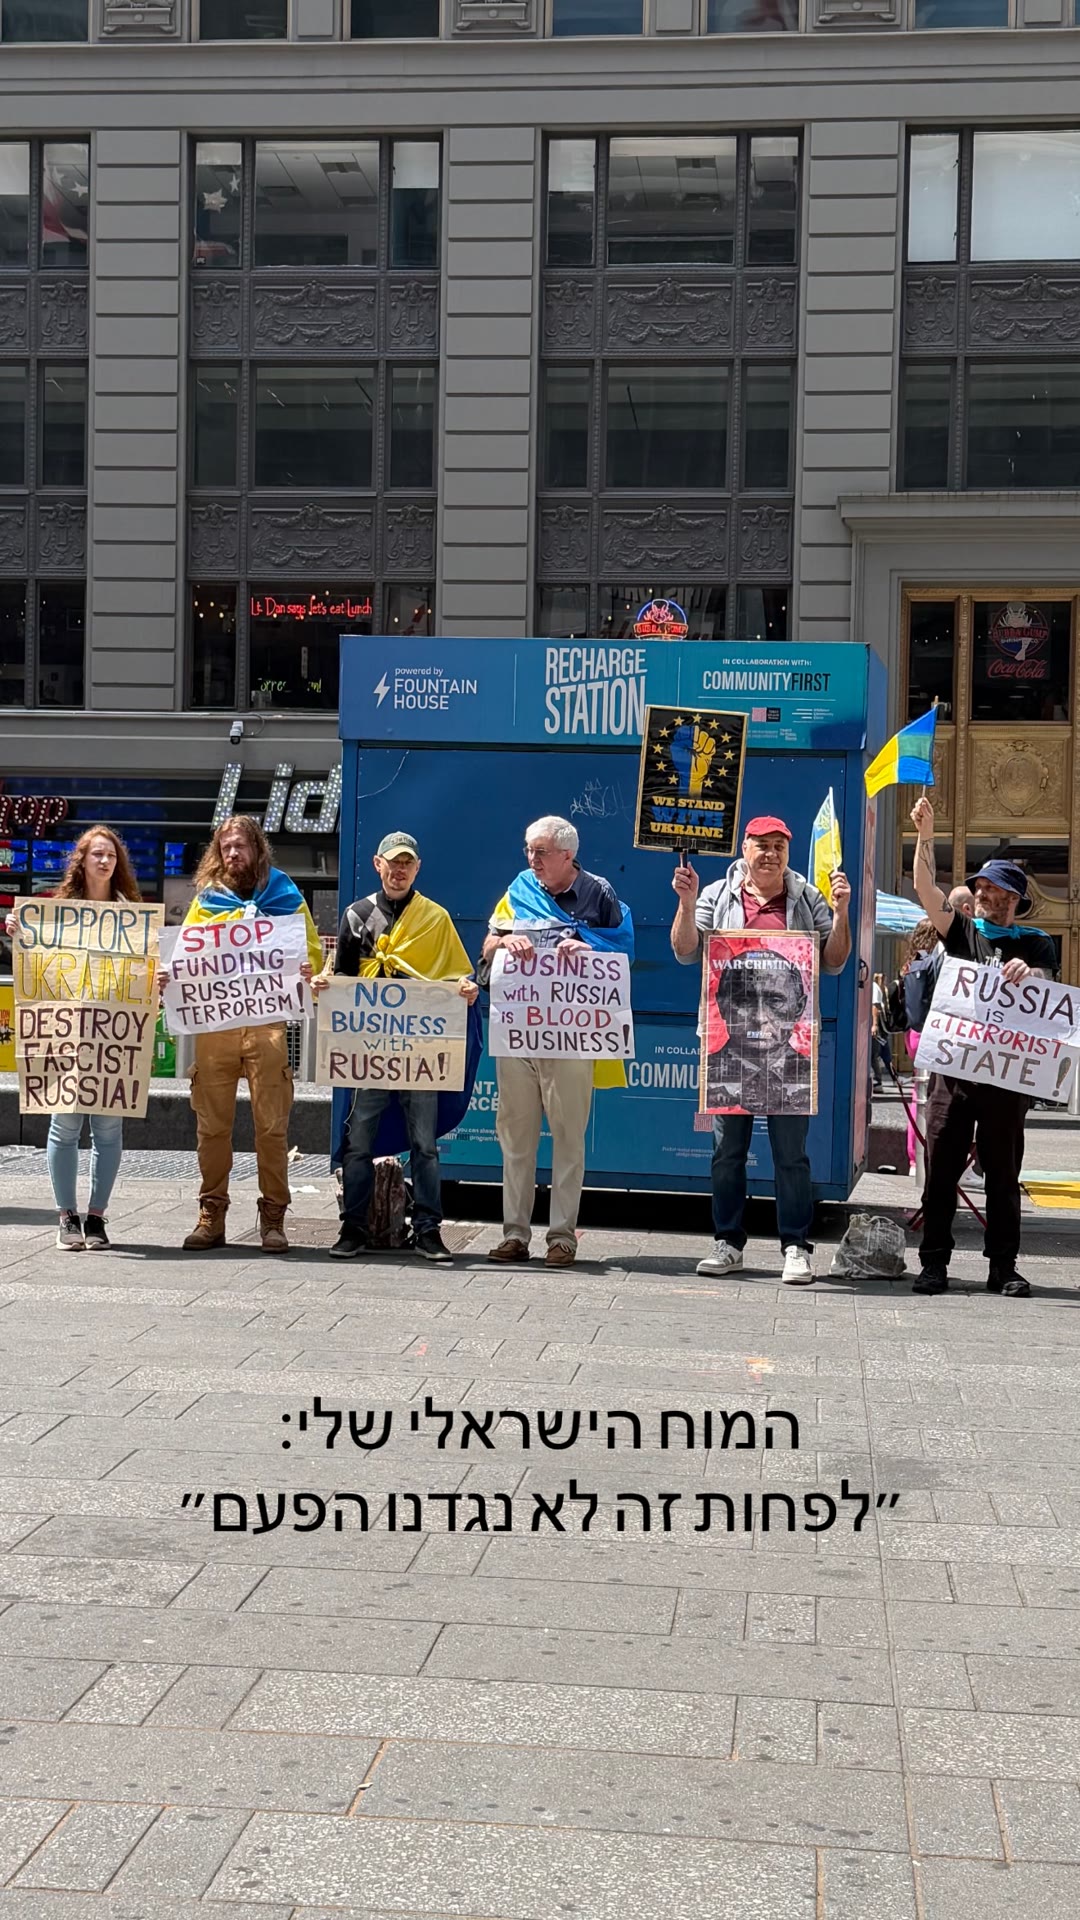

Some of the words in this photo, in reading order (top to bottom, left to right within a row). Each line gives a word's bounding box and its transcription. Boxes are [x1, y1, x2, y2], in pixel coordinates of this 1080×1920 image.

[264, 597, 285, 616] Dan
[329, 603, 345, 614] eat
[347, 597, 373, 618] Lunch
[394, 667, 431, 676] powered
[432, 666, 444, 677] by
[545, 647, 648, 685] RECHARGE
[731, 658, 789, 666] COLLABORATION
[394, 678, 478, 695] FOUNTAIN
[702, 670, 831, 692] COMMUNITYFIRST
[394, 694, 450, 710] HOUSE
[544, 675, 646, 735] STATION
[211, 762, 342, 834] Lid
[652, 795, 676, 807] WE
[677, 798, 726, 811] STAND
[650, 821, 724, 839] UKRAINE
[651, 806, 725, 828] WITH
[19, 903, 158, 956] SUPPORT
[182, 920, 274, 953] STOP
[172, 948, 284, 980] FUNDING
[502, 952, 621, 982] BUSINESS
[712, 959, 742, 969] WAR
[744, 959, 808, 970] CRIMINAL
[17, 952, 156, 1005] UKRAINE!
[181, 973, 284, 1004] RUSSIAN
[176, 982, 305, 1025] TERRORISM!
[354, 981, 407, 1008] NO
[502, 984, 540, 1002] with
[551, 981, 622, 1006] RUSSIA
[951, 966, 1074, 1026] RUSSIA
[20, 1007, 149, 1043] DESTROY
[331, 1010, 447, 1036] BUSINESS
[501, 1011, 514, 1024] is
[527, 1006, 612, 1029] BLOOD
[985, 1008, 1005, 1024] is
[363, 1038, 413, 1051] with
[508, 1024, 630, 1055] BUSINESS!
[944, 1012, 1064, 1059] TERRORIST
[24, 1042, 142, 1076] FASCIST
[654, 1046, 664, 1054] IN
[329, 1052, 446, 1082] RUSSIA!
[628, 1061, 700, 1090] COMMU
[25, 1075, 140, 1110] RUSSIA!
[472, 1080, 498, 1098] NT,
[467, 1096, 500, 1112] RCE
